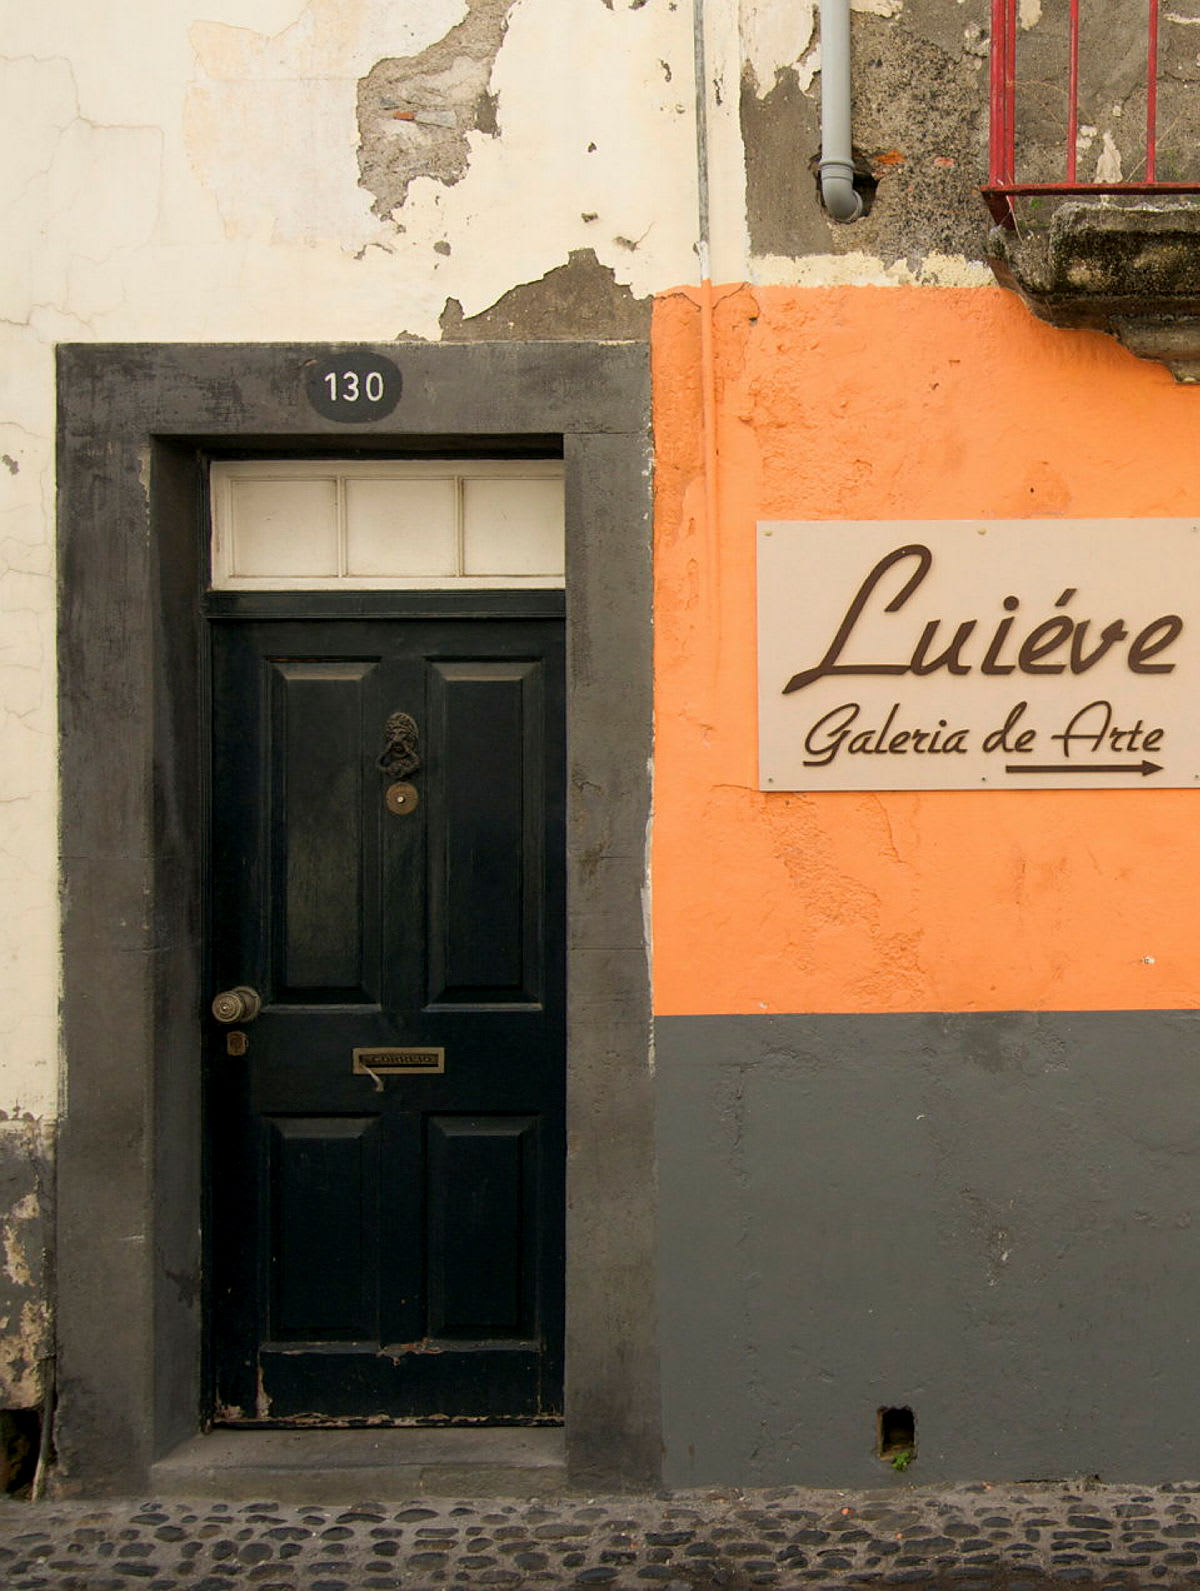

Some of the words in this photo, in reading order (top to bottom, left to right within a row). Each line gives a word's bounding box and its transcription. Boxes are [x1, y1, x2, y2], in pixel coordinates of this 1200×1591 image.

[324, 371, 384, 402] 130
[782, 544, 1184, 695] Luiéve
[803, 702, 970, 767] Galeria
[983, 701, 1036, 754] de
[1051, 700, 1165, 758] Arte
